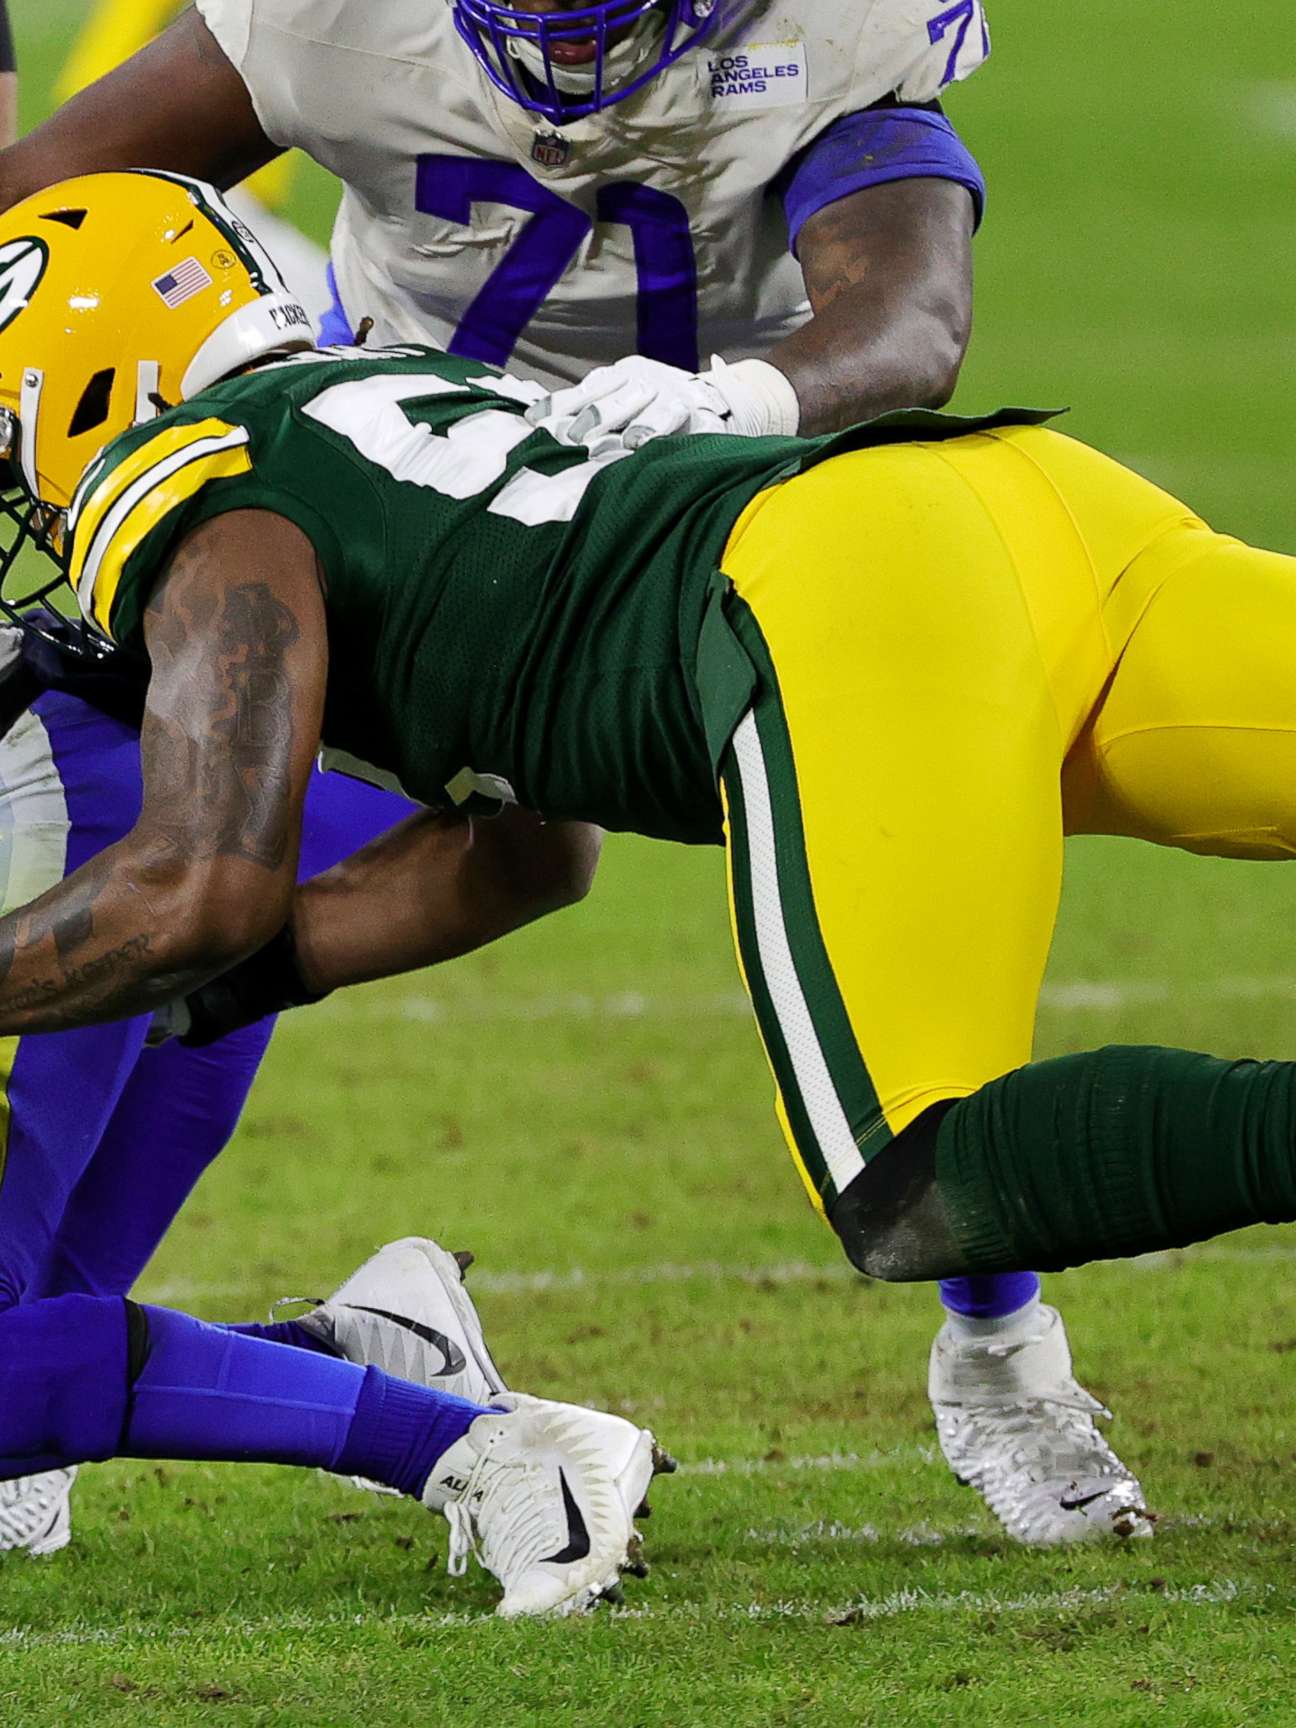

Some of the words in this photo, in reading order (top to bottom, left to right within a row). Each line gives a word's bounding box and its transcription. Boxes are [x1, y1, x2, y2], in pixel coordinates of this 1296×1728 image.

[708, 55, 748, 72] LOS
[711, 64, 799, 85] ANGELES
[712, 81, 766, 98] RAMS
[439, 1475, 484, 1502] ALA
